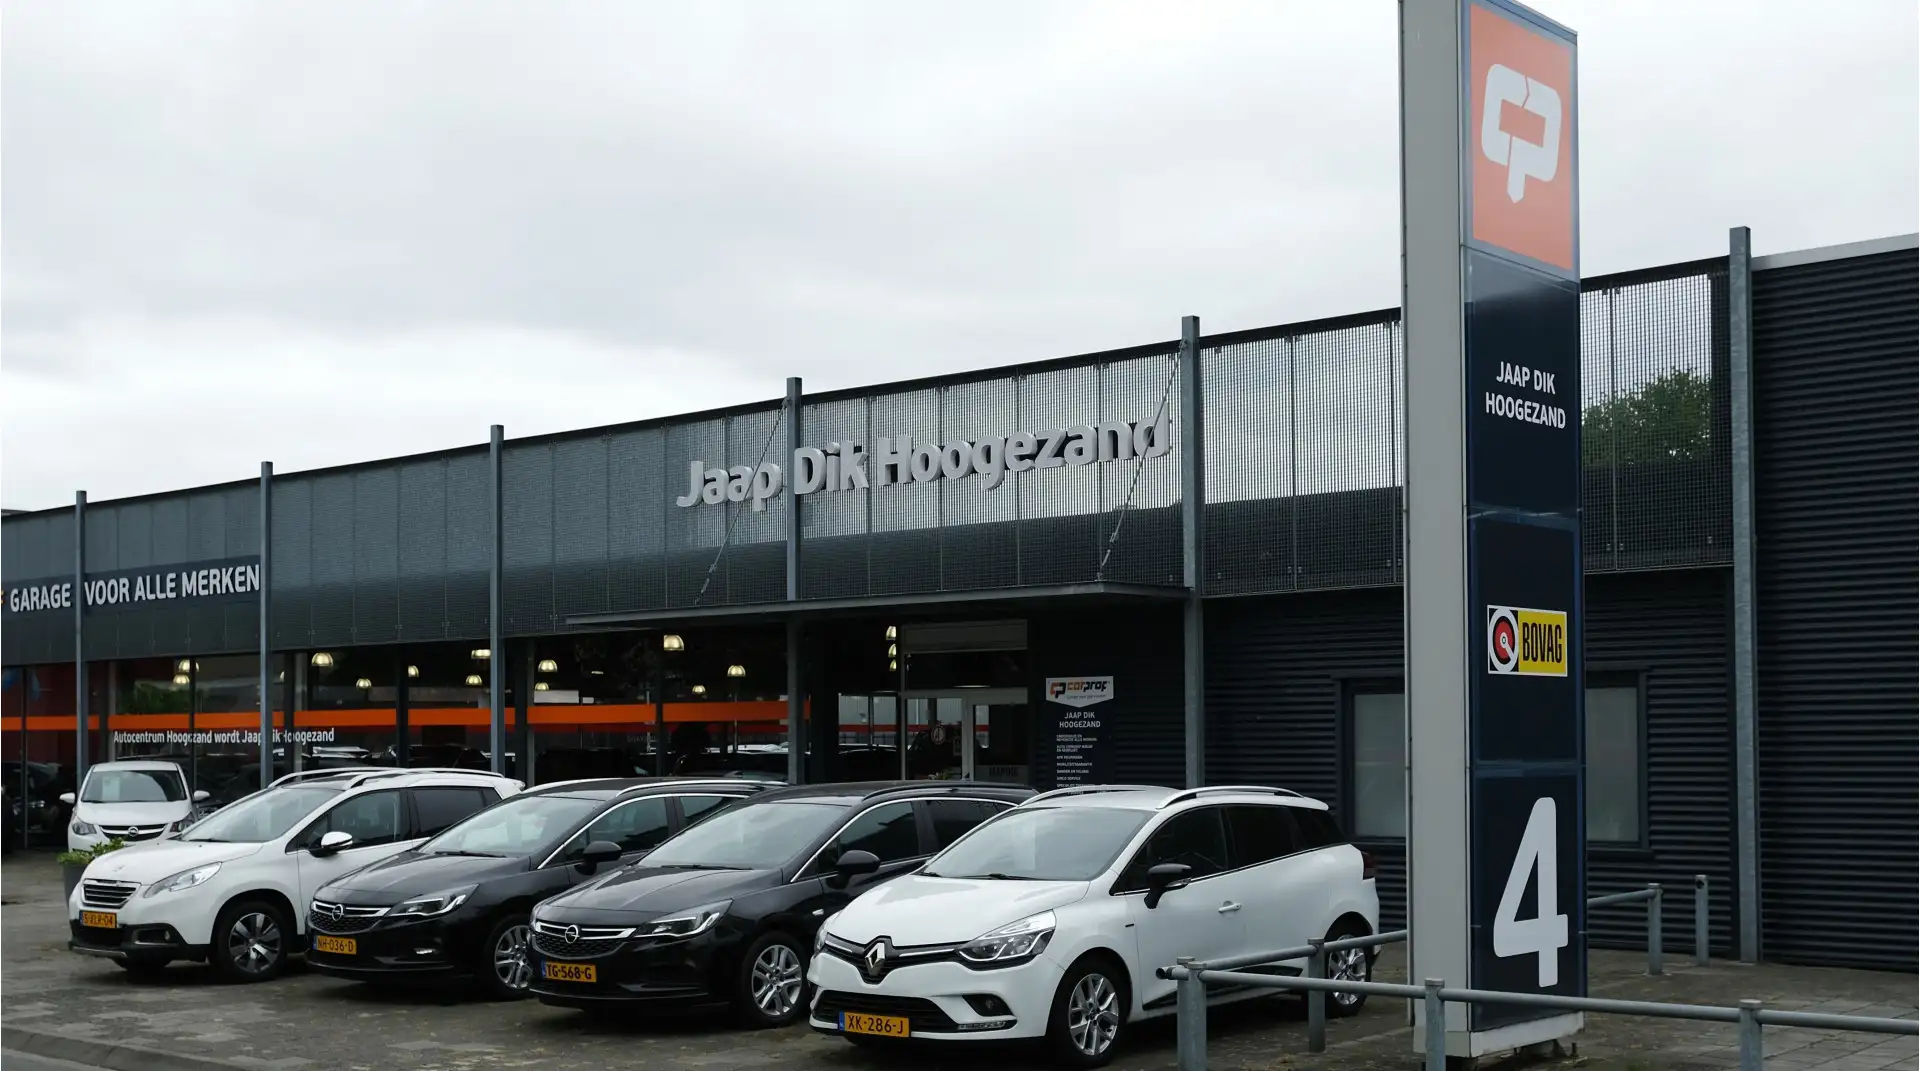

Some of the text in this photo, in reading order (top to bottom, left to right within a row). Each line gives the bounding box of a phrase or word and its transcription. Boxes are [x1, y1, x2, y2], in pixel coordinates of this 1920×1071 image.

[1496, 361, 1555, 394] JAAP DIK
[1485, 391, 1566, 429] HOOGEZAND
[676, 401, 1169, 512] Jaap Dik Hoogezand
[10, 564, 260, 612] GARAGE VOOR ALLE MERKEN
[1522, 622, 1562, 663] BOVAG
[1059, 720, 1101, 728] HOOGEZAND
[1064, 711, 1096, 719] JAAP DIK
[113, 730, 164, 744] Autocentrum
[166, 730, 212, 746] Hoogezand
[214, 729, 240, 743] wordt
[1493, 796, 1568, 988] 4
[546, 964, 592, 980] TG-568-G
[848, 1014, 904, 1034] XK-286-J
